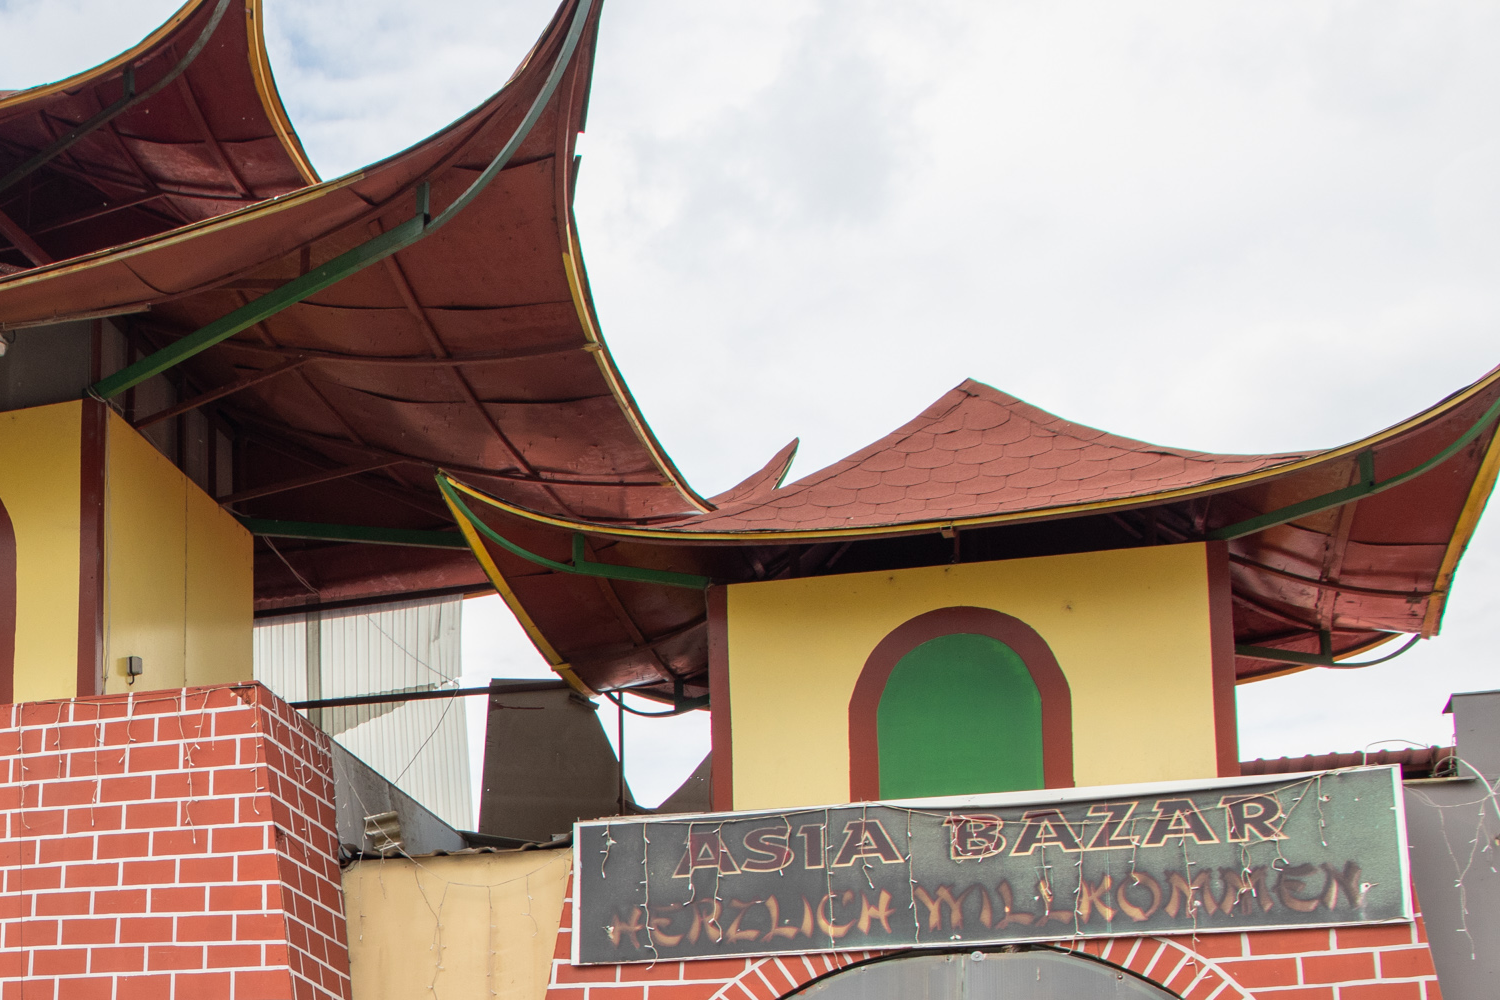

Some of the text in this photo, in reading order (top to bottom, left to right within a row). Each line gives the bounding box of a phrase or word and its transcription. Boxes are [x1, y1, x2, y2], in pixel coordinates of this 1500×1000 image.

[672, 792, 1289, 879] ASIA BAZAR
[609, 860, 1366, 949] HERZLICH WILLKOMMEN
